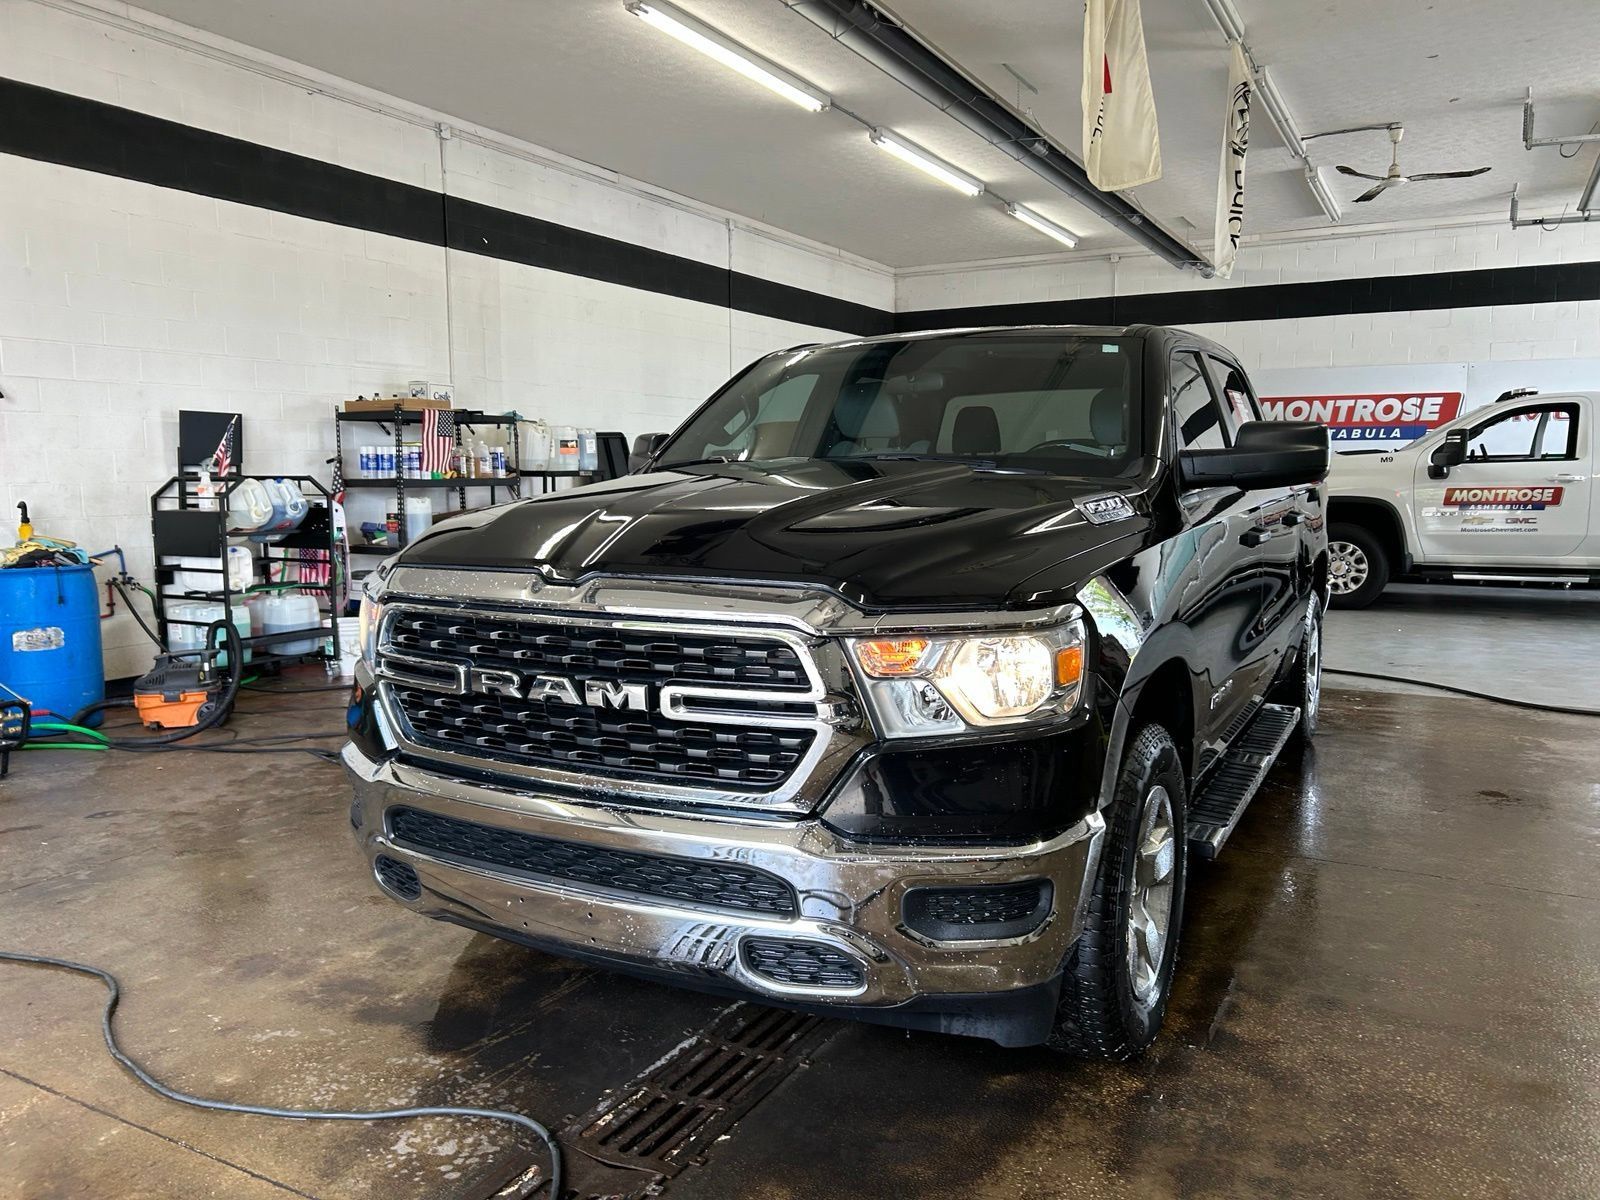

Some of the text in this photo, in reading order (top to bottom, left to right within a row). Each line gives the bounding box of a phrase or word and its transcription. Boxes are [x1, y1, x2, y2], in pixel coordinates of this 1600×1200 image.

[1262, 397, 1444, 423] MONTROSE
[1328, 428, 1401, 439] TABULA
[1380, 456, 1394, 464] M9
[1451, 489, 1554, 502] MONTROSE
[471, 667, 648, 711] RAM
